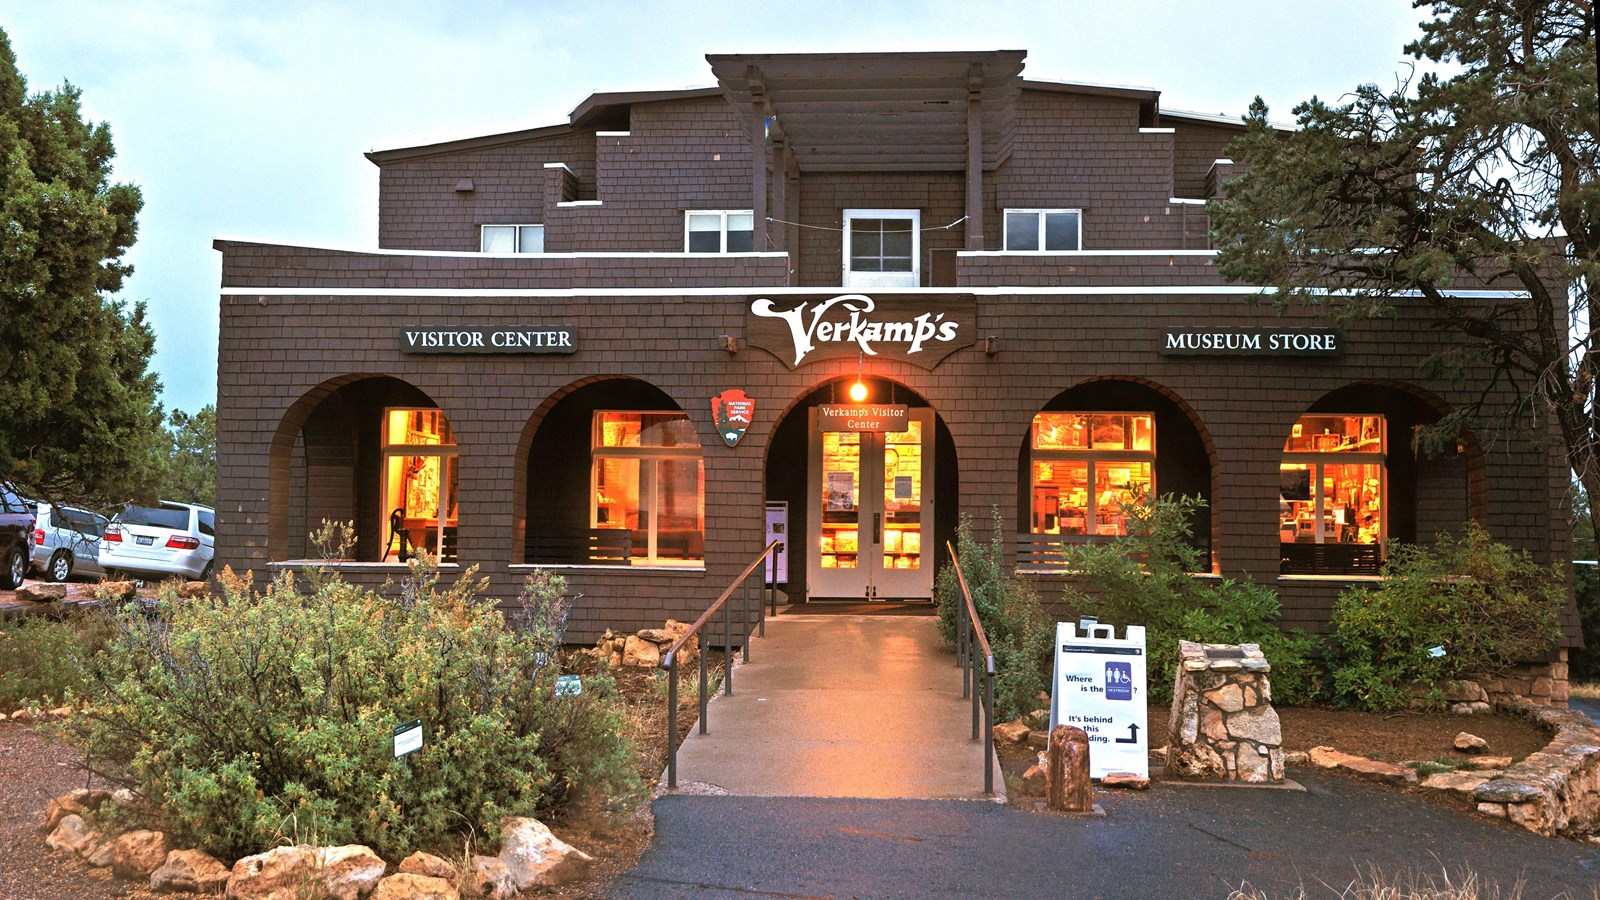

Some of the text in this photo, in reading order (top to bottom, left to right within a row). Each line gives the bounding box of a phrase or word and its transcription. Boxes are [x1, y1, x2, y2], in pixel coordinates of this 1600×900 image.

[750, 294, 960, 367] Verkamp's
[405, 331, 572, 347] VISITOR CENTER
[1165, 333, 1336, 350] MUSEUM STORE
[823, 407, 904, 418] Verkamp's Visitor
[847, 419, 880, 428] Center
[1080, 684, 1088, 692] is
[1083, 715, 1113, 723] behind
[1088, 734, 1110, 743] ding.
